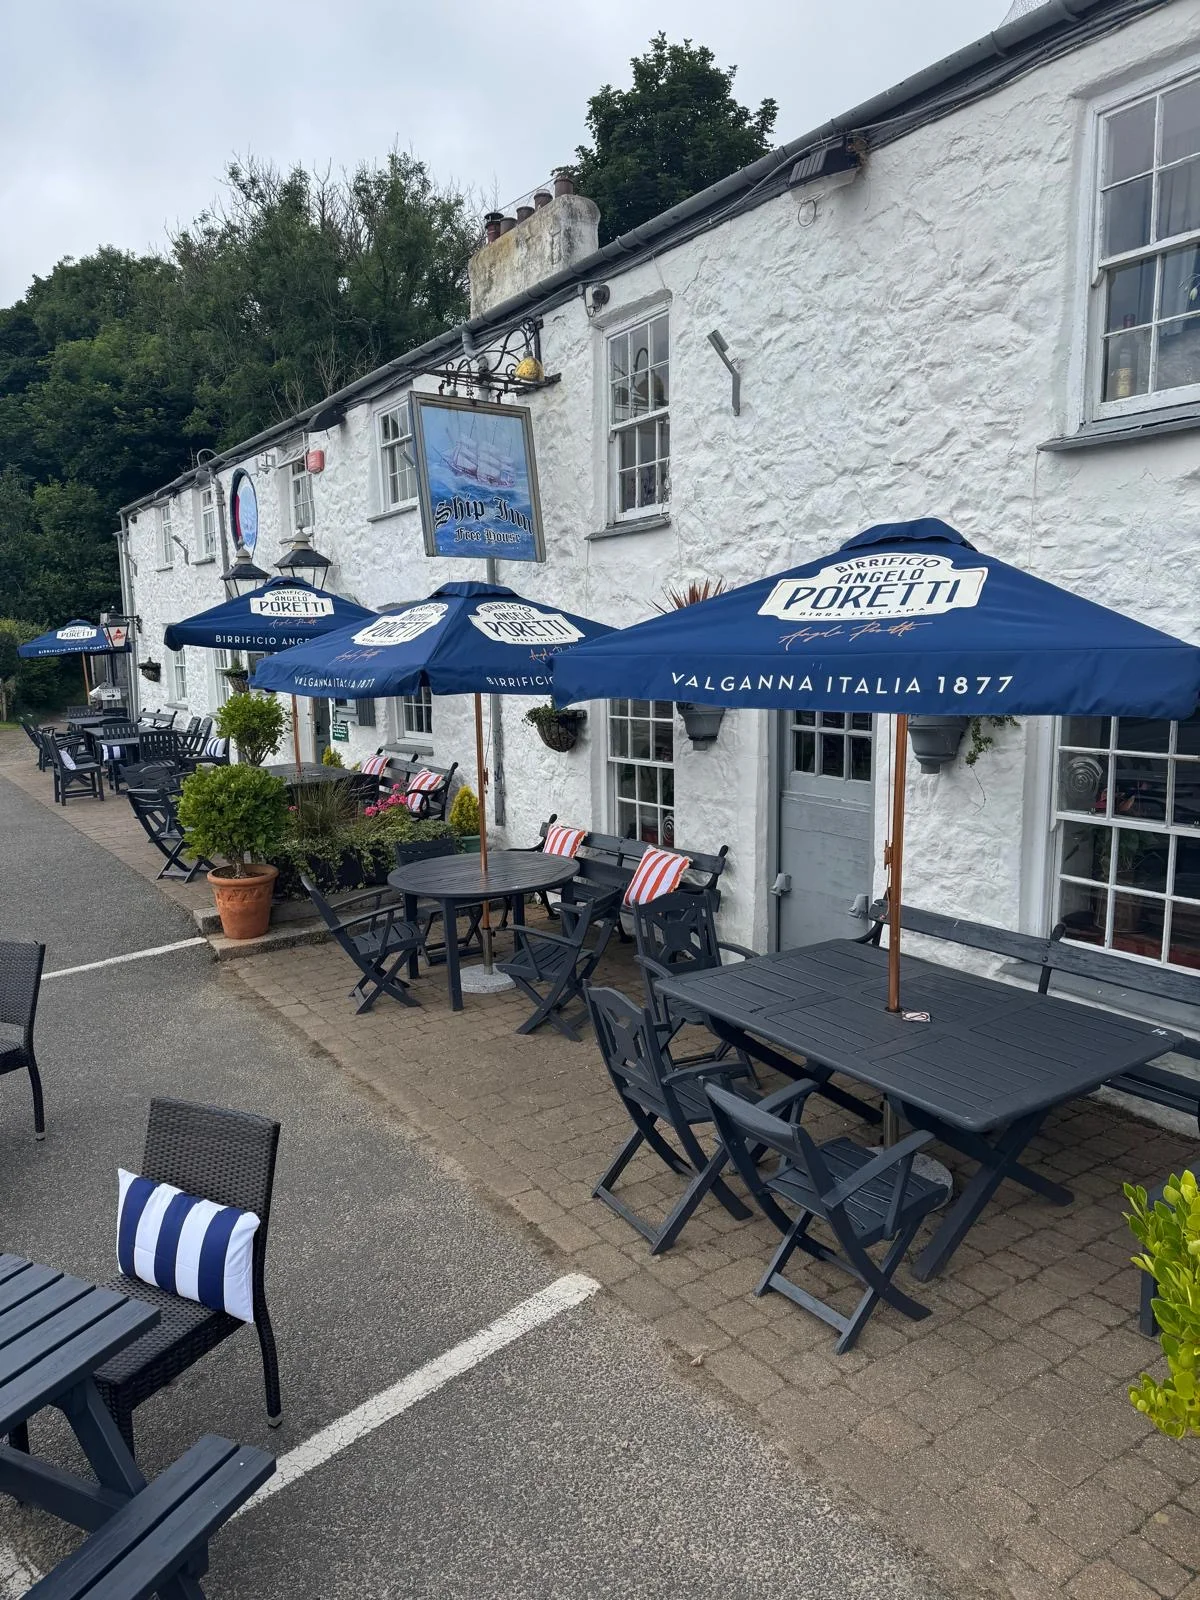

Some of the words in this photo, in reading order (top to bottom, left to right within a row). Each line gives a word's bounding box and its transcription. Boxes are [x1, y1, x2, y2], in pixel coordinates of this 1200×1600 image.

[435, 494, 485, 529] Ship
[493, 497, 533, 534] Inn
[454, 527, 481, 541] Free
[484, 528, 521, 543] House
[835, 556, 941, 573] BIRRIFICIO
[837, 568, 925, 585] ANGELO
[270, 589, 312, 597] BIRRIFICIO
[783, 579, 961, 610] PORETTI
[259, 601, 325, 613] PORETTI
[851, 607, 925, 616] ITALIANA
[493, 612, 536, 621] ANGELO
[362, 621, 433, 638] PORETTI
[483, 619, 572, 637] PORETTI
[215, 634, 277, 645] BIRRIFICIO
[671, 671, 814, 692] VALGANNA
[826, 675, 922, 695] ITALIA
[936, 675, 1014, 695] 1877
